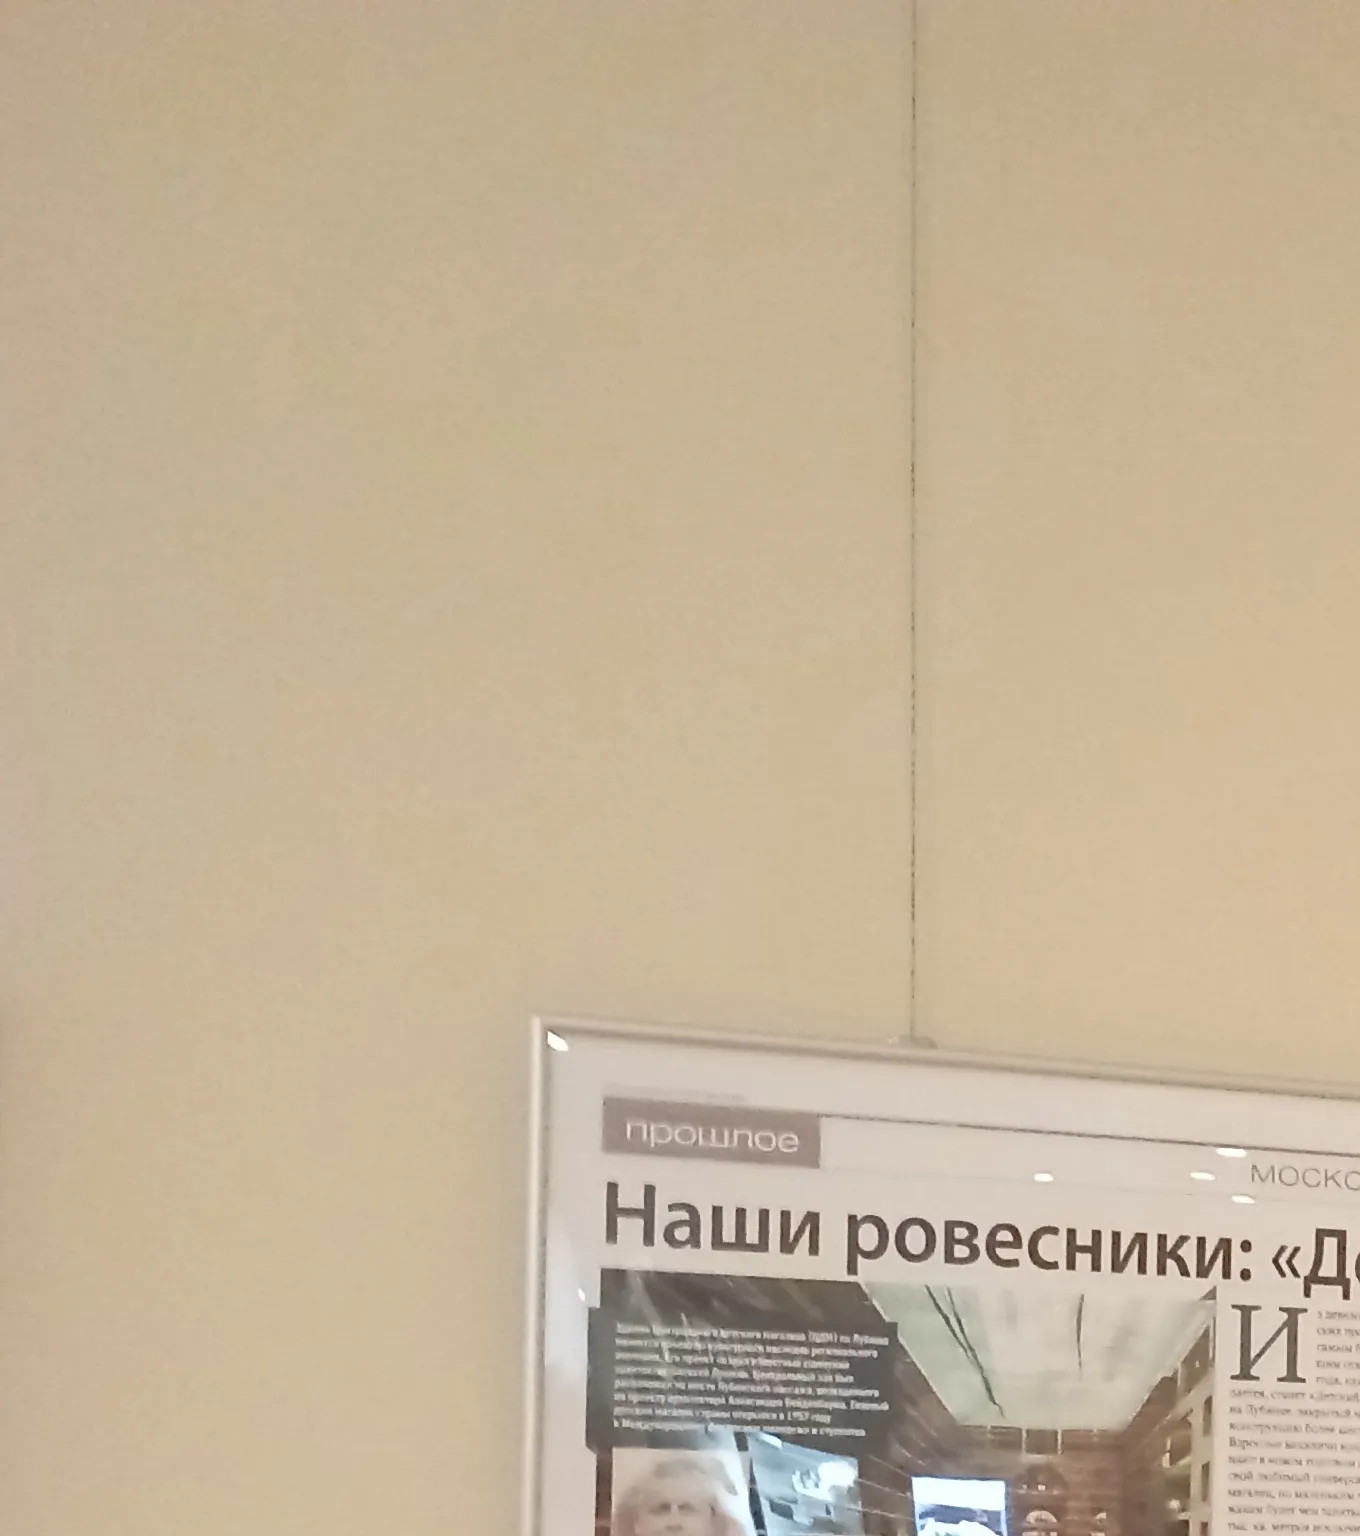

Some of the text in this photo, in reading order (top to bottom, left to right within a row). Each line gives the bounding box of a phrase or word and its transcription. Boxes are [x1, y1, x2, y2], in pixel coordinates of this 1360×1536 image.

[625, 1119, 799, 1154] прошлое
[605, 1181, 821, 1257] Наши
[846, 1212, 1254, 1282] ровесники:
